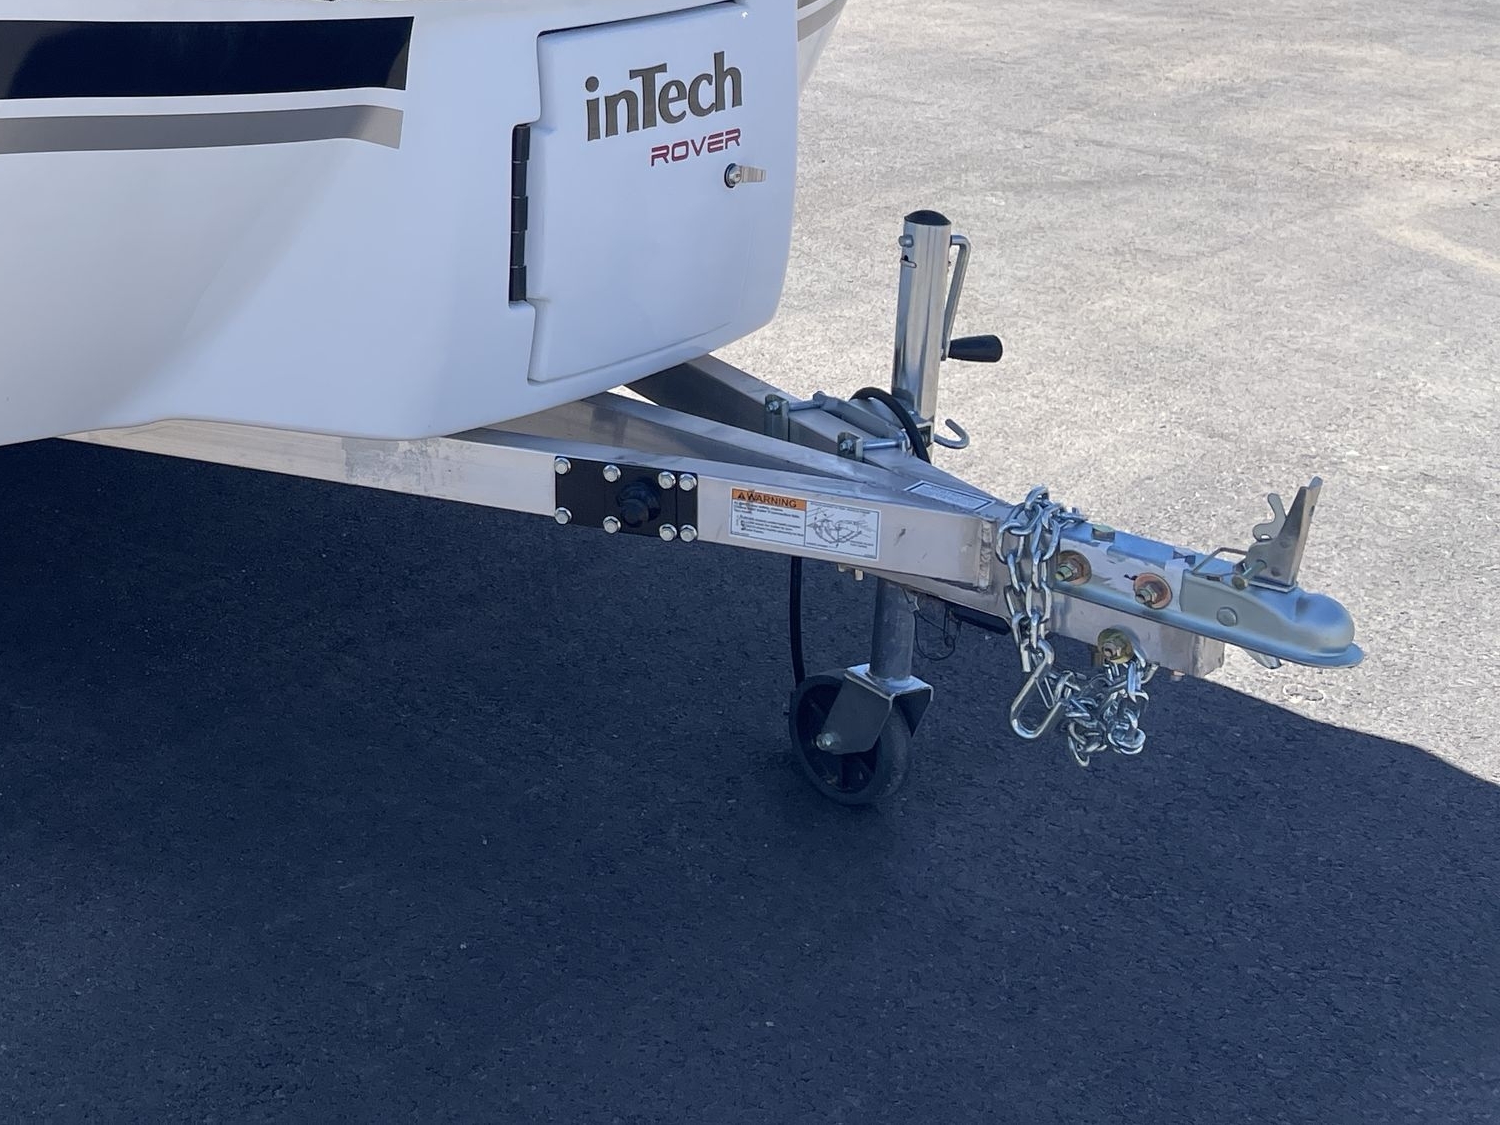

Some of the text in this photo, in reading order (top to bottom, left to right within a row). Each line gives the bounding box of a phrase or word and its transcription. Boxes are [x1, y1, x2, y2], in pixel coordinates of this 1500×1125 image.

[585, 51, 742, 142] inTech
[651, 128, 741, 167] ROVER
[747, 491, 797, 508] WARNING
